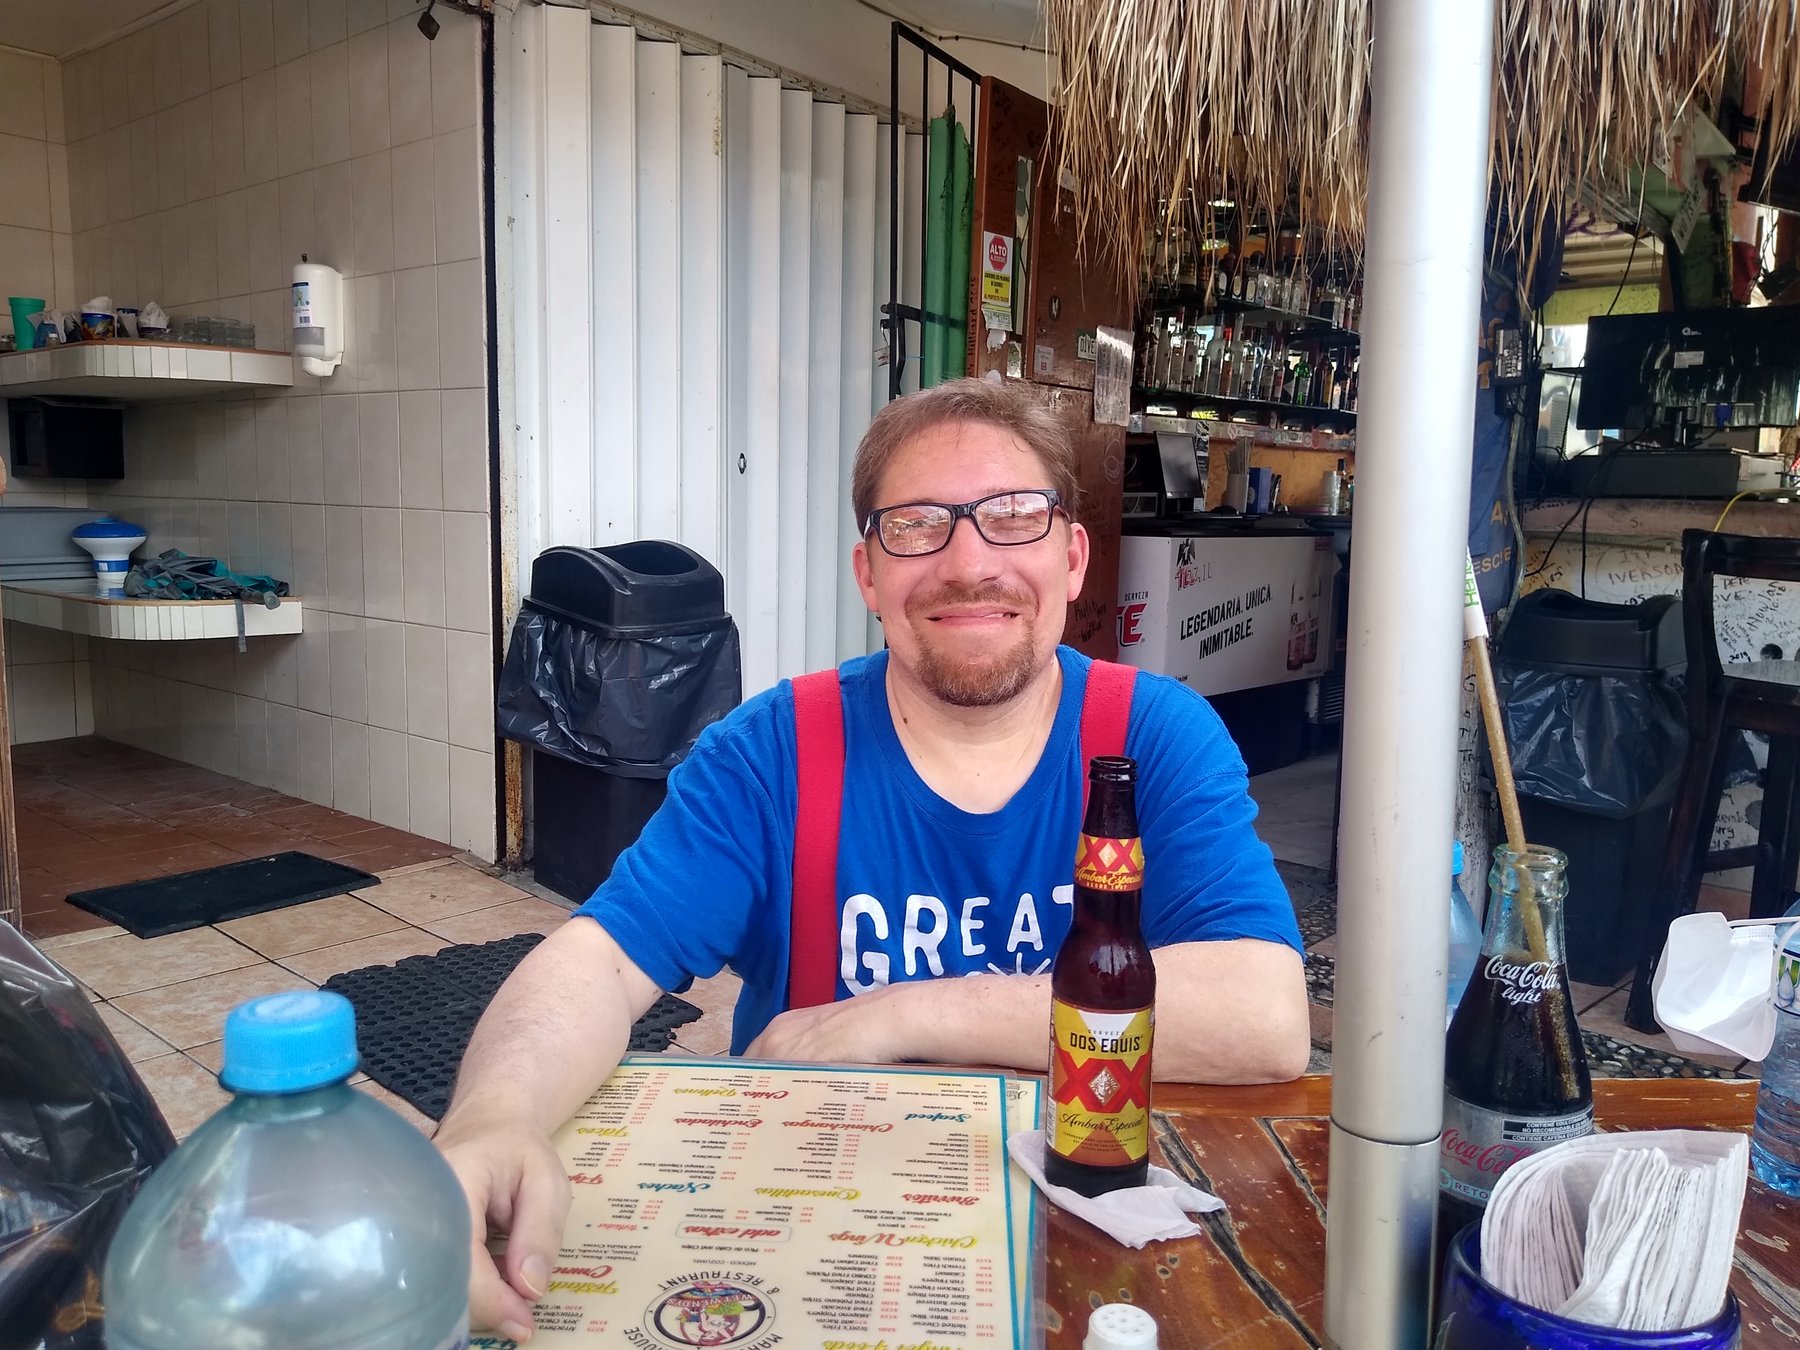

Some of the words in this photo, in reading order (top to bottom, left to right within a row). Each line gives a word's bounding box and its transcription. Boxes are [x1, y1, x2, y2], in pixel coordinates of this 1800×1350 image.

[990, 244, 1007, 257] ALTO
[1180, 596, 1243, 640] LEGENDARIA.
[1199, 618, 1254, 660] INIMITABLE.
[1484, 954, 1558, 989] Coca-Cola
[1502, 988, 1542, 1005] light
[1070, 1032, 1096, 1052] DOS
[1101, 1036, 1140, 1054] EQUIS
[674, 1118, 763, 1129] Enchiladas
[904, 1113, 971, 1122] Seafood
[1059, 1113, 1105, 1132] Ambar
[1104, 1114, 1145, 1135] Especial
[576, 1127, 629, 1137] Tacos
[782, 1120, 893, 1132] Chimichangas
[637, 1182, 710, 1193] Nachos
[753, 1186, 861, 1201] Quesadillas
[1454, 1182, 1489, 1199] RETO
[902, 1194, 980, 1206] Burritos
[683, 1226, 739, 1236] extras
[738, 1228, 781, 1239] add
[828, 1231, 905, 1247] Wings
[905, 1234, 976, 1249] Chicken
[552, 1266, 612, 1278] Crunc
[549, 1280, 619, 1294] Tostad
[658, 1271, 764, 1291] RESTAURANT
